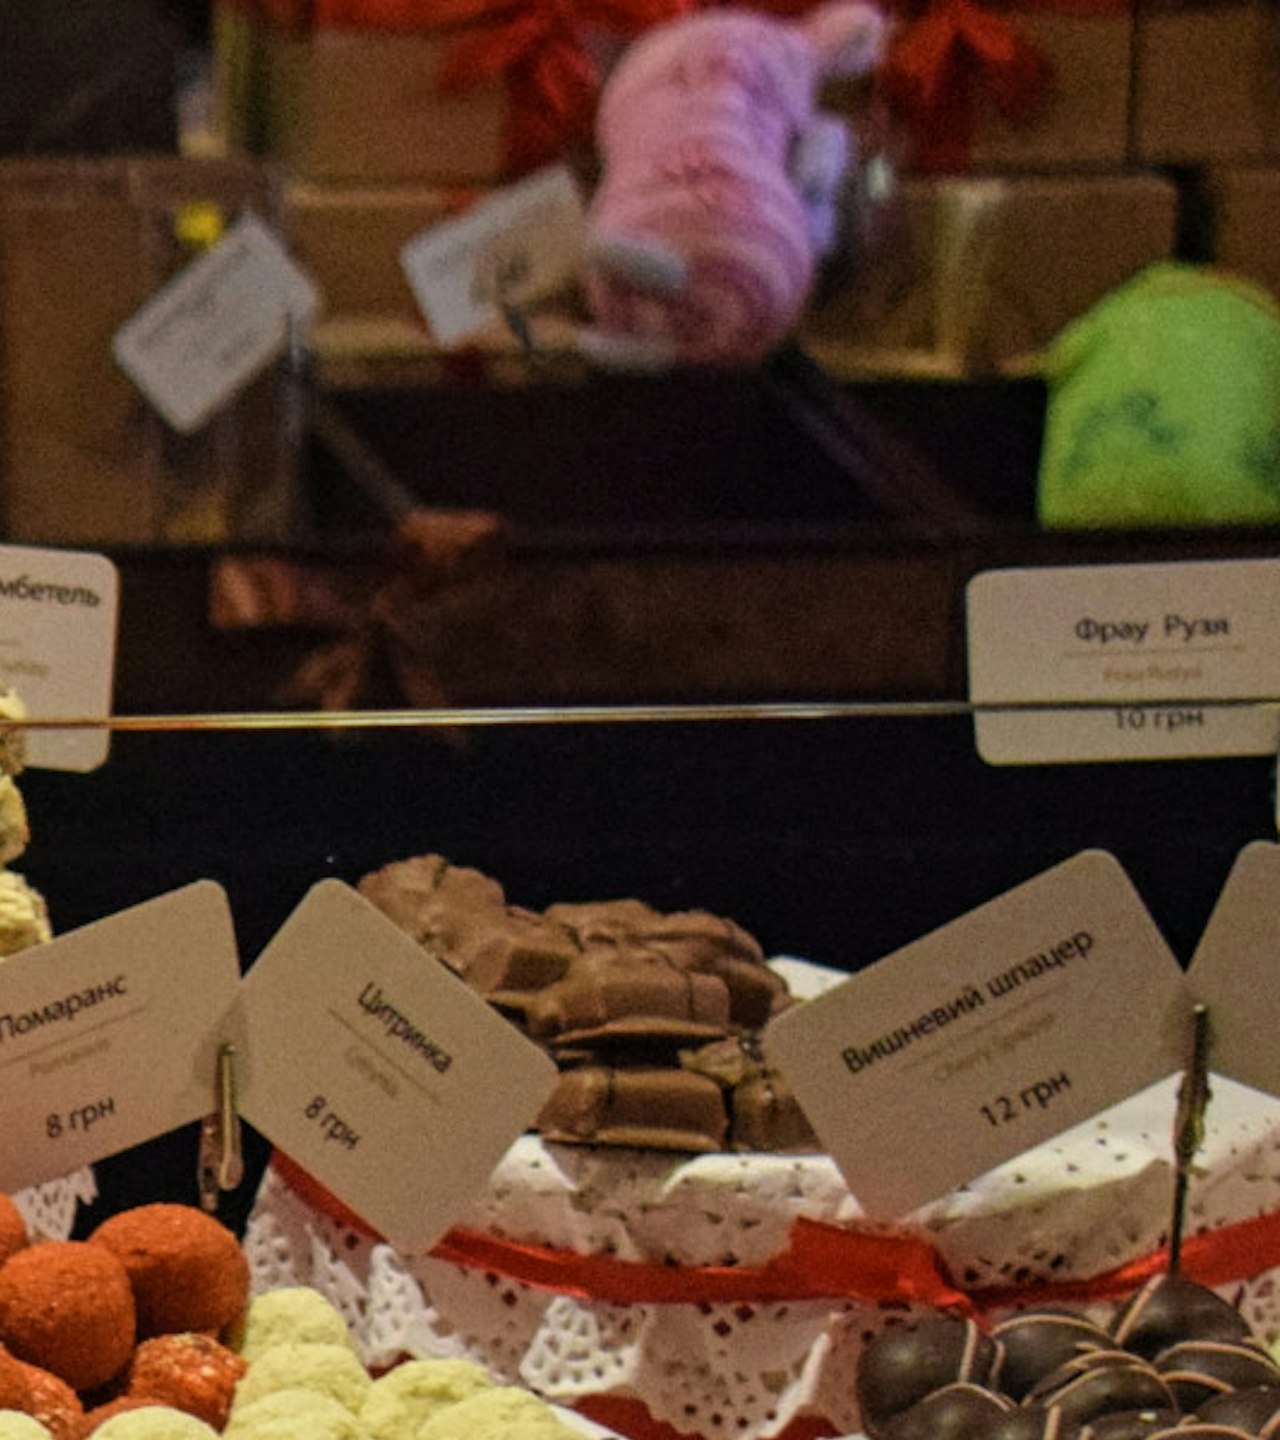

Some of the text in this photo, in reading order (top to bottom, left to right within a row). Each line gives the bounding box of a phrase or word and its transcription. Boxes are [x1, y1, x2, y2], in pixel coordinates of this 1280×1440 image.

[1075, 613, 1230, 644] Фрау Рузя
[1114, 704, 1204, 734] 10 грн
[356, 980, 453, 1074] Цитринка
[842, 984, 985, 1074] Вишневий
[987, 930, 1094, 998] шпацер
[44, 1096, 116, 1140] 8 грн
[304, 1094, 362, 1152] 8 грн
[978, 1068, 1072, 1129] 12 грн
